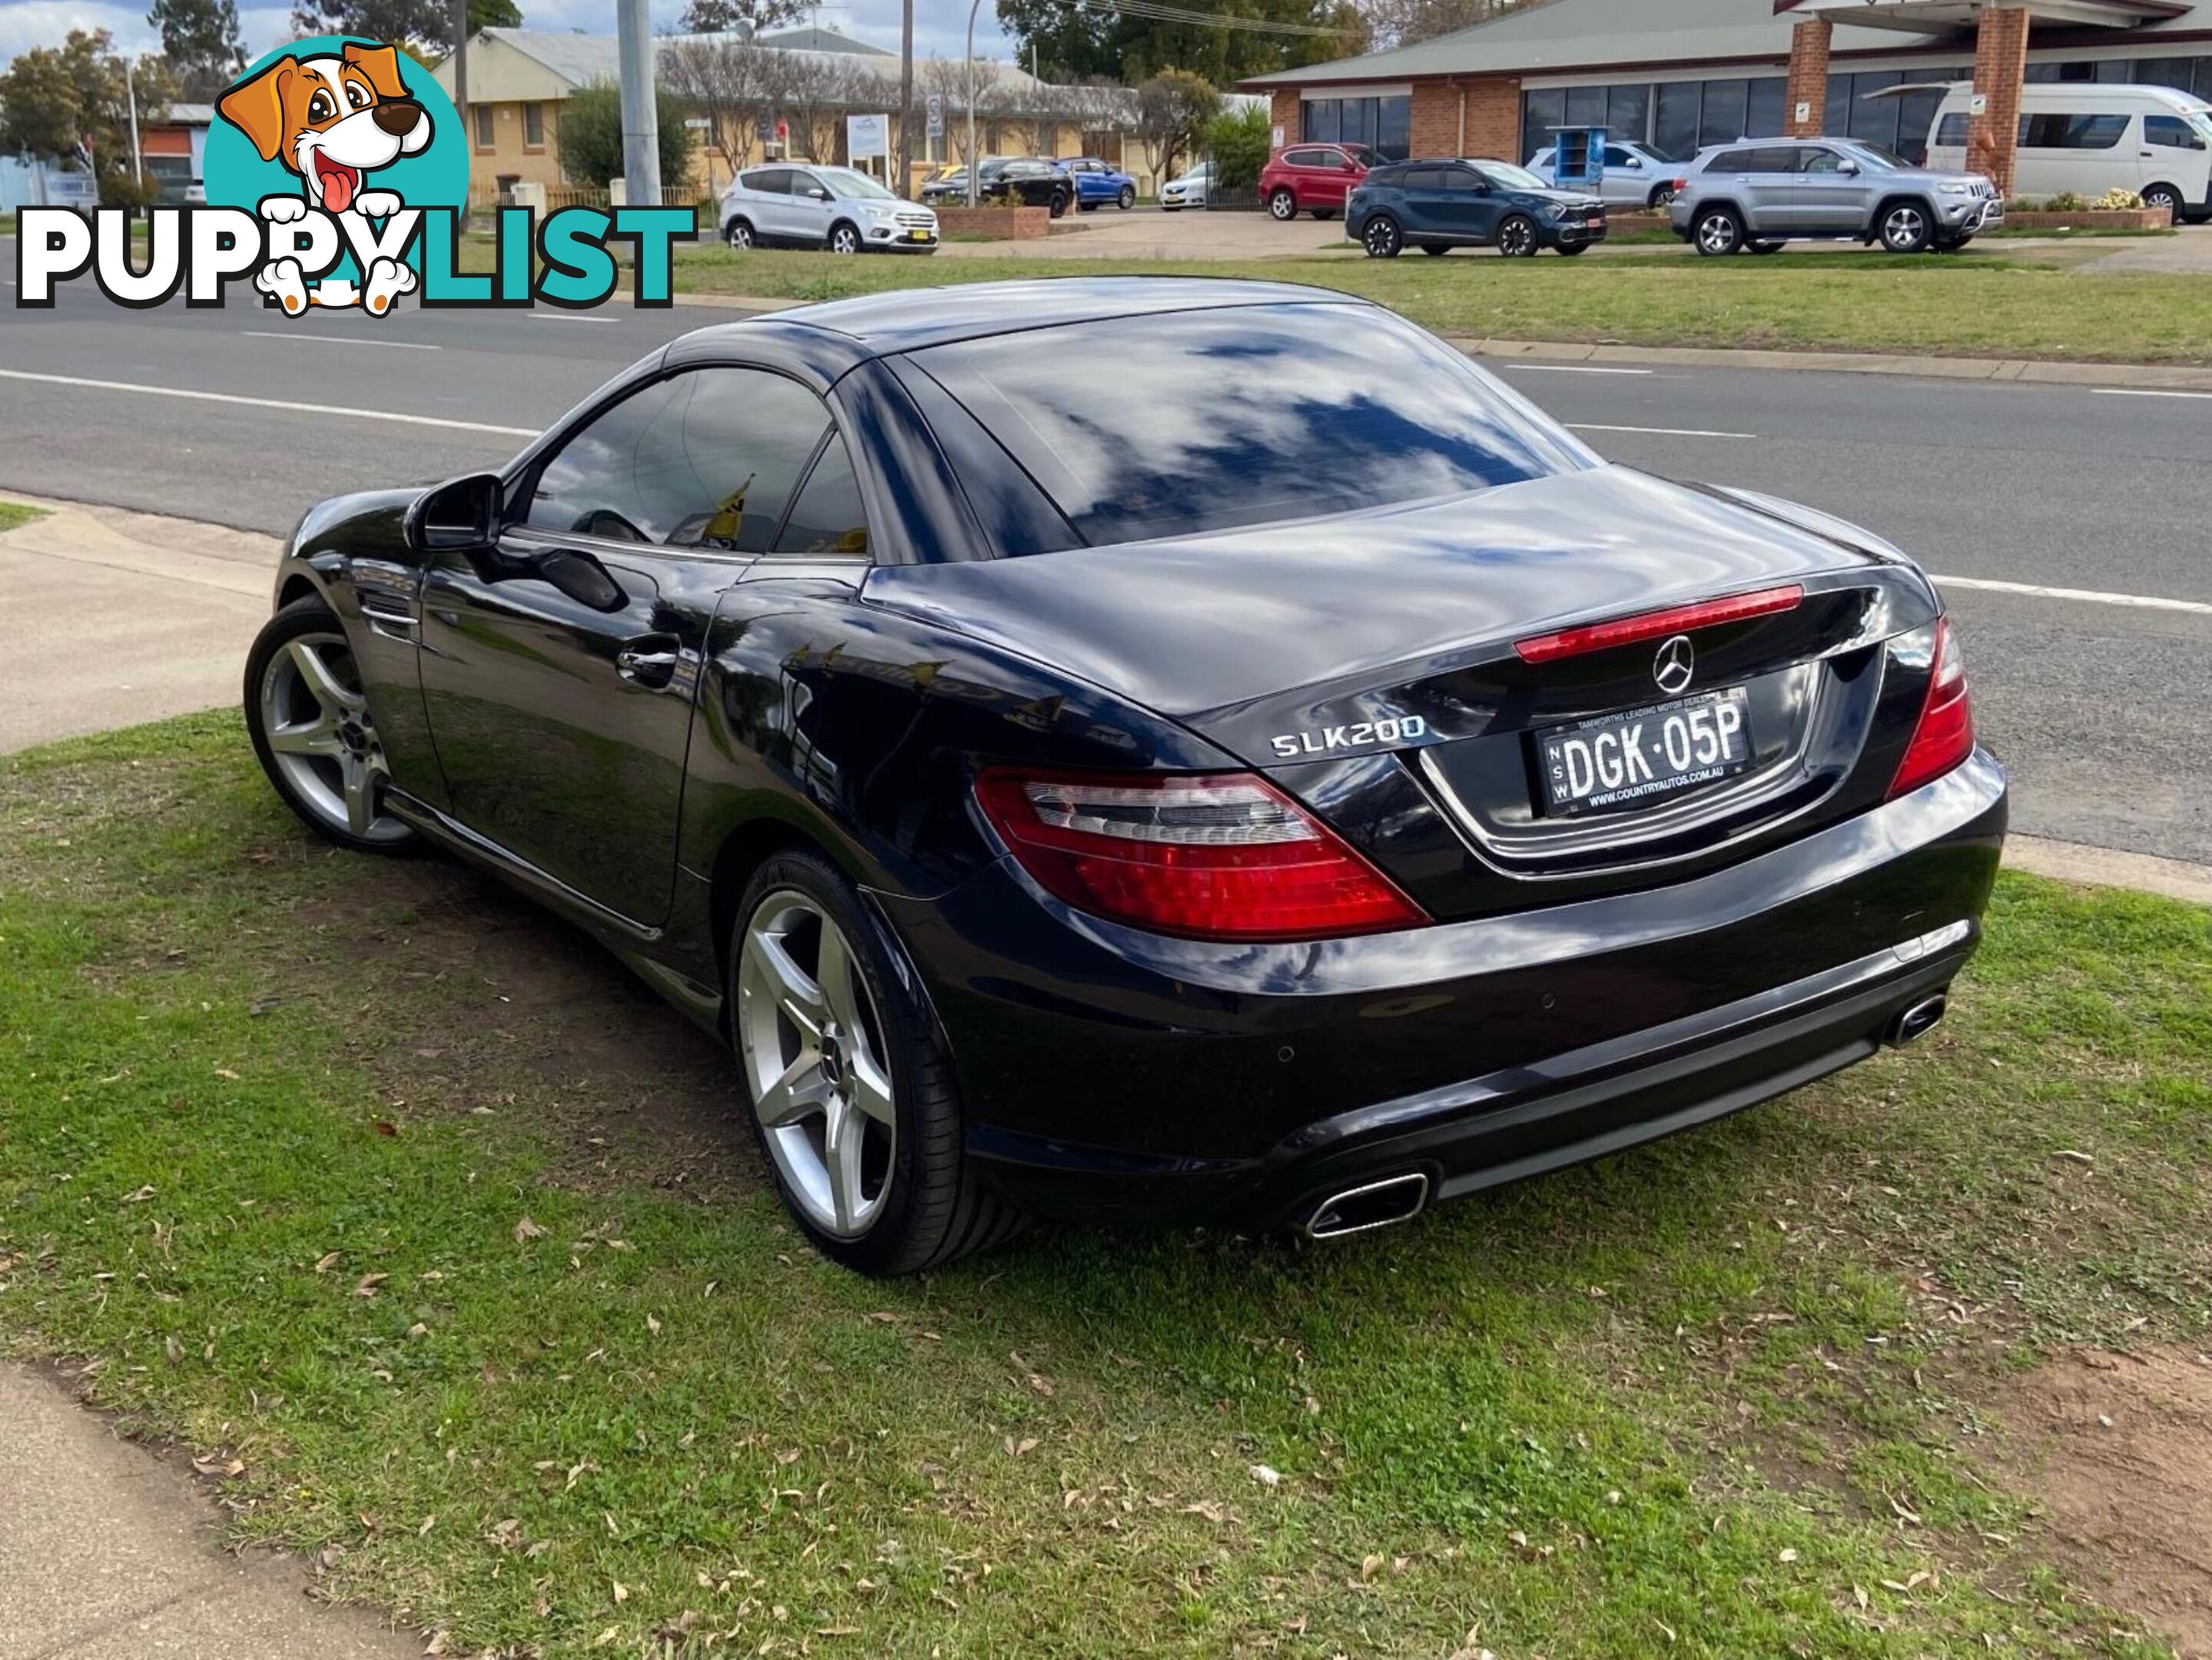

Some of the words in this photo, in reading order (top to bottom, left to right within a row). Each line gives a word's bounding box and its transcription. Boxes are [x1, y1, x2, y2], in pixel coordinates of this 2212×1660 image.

[1578, 714, 1625, 730] TAMWORTHS
[1625, 706, 1657, 719] LEADING
[1657, 699, 1683, 710] MOTOR
[1271, 715, 1425, 758] SLK200
[1589, 767, 1724, 807] WWW.COUNTRYAUTOS.COM.AU
